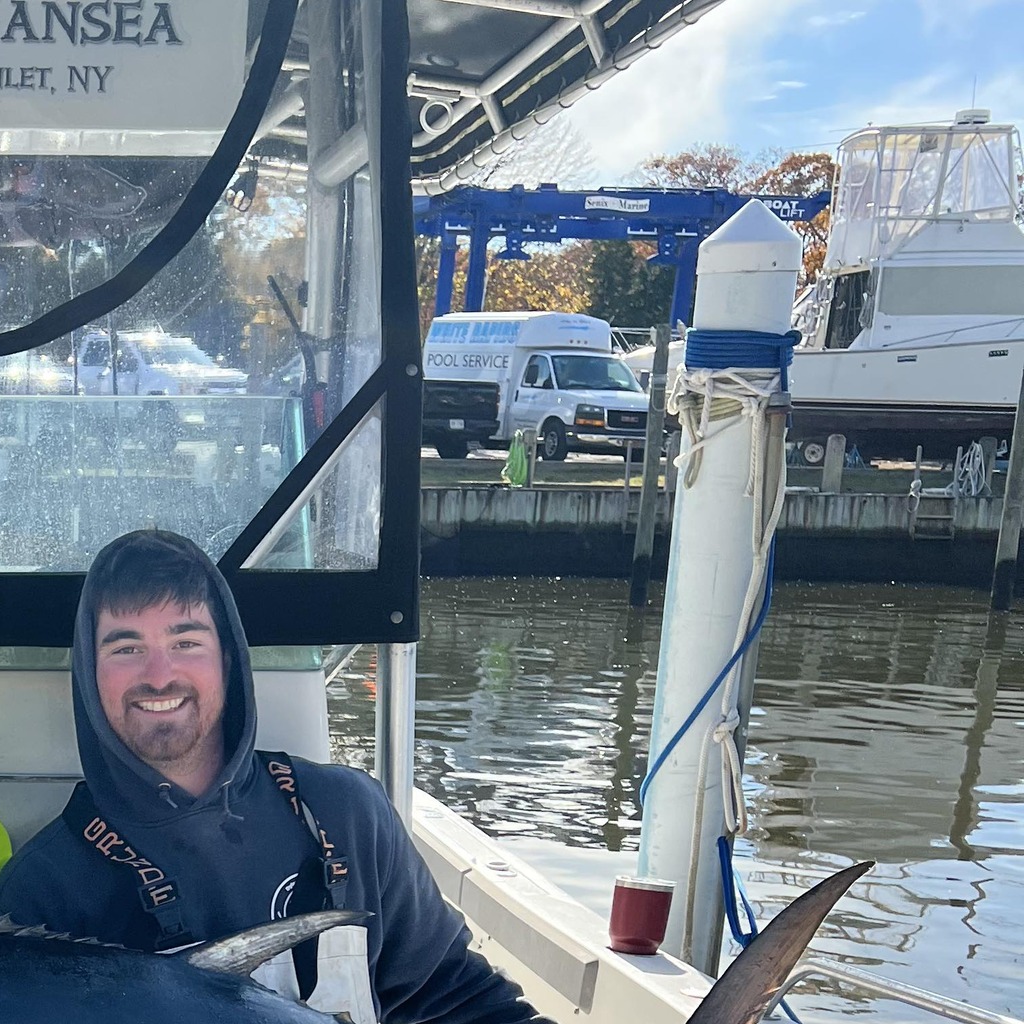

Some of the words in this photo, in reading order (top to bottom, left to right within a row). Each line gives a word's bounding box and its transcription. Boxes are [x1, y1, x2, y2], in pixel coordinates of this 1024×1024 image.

[67, 65, 114, 93] NY
[619, 199, 648, 210] Marine
[763, 200, 799, 209] BOAT
[779, 208, 805, 217] LIFT
[427, 353, 459, 367] POOL
[462, 354, 509, 368] SERVICE
